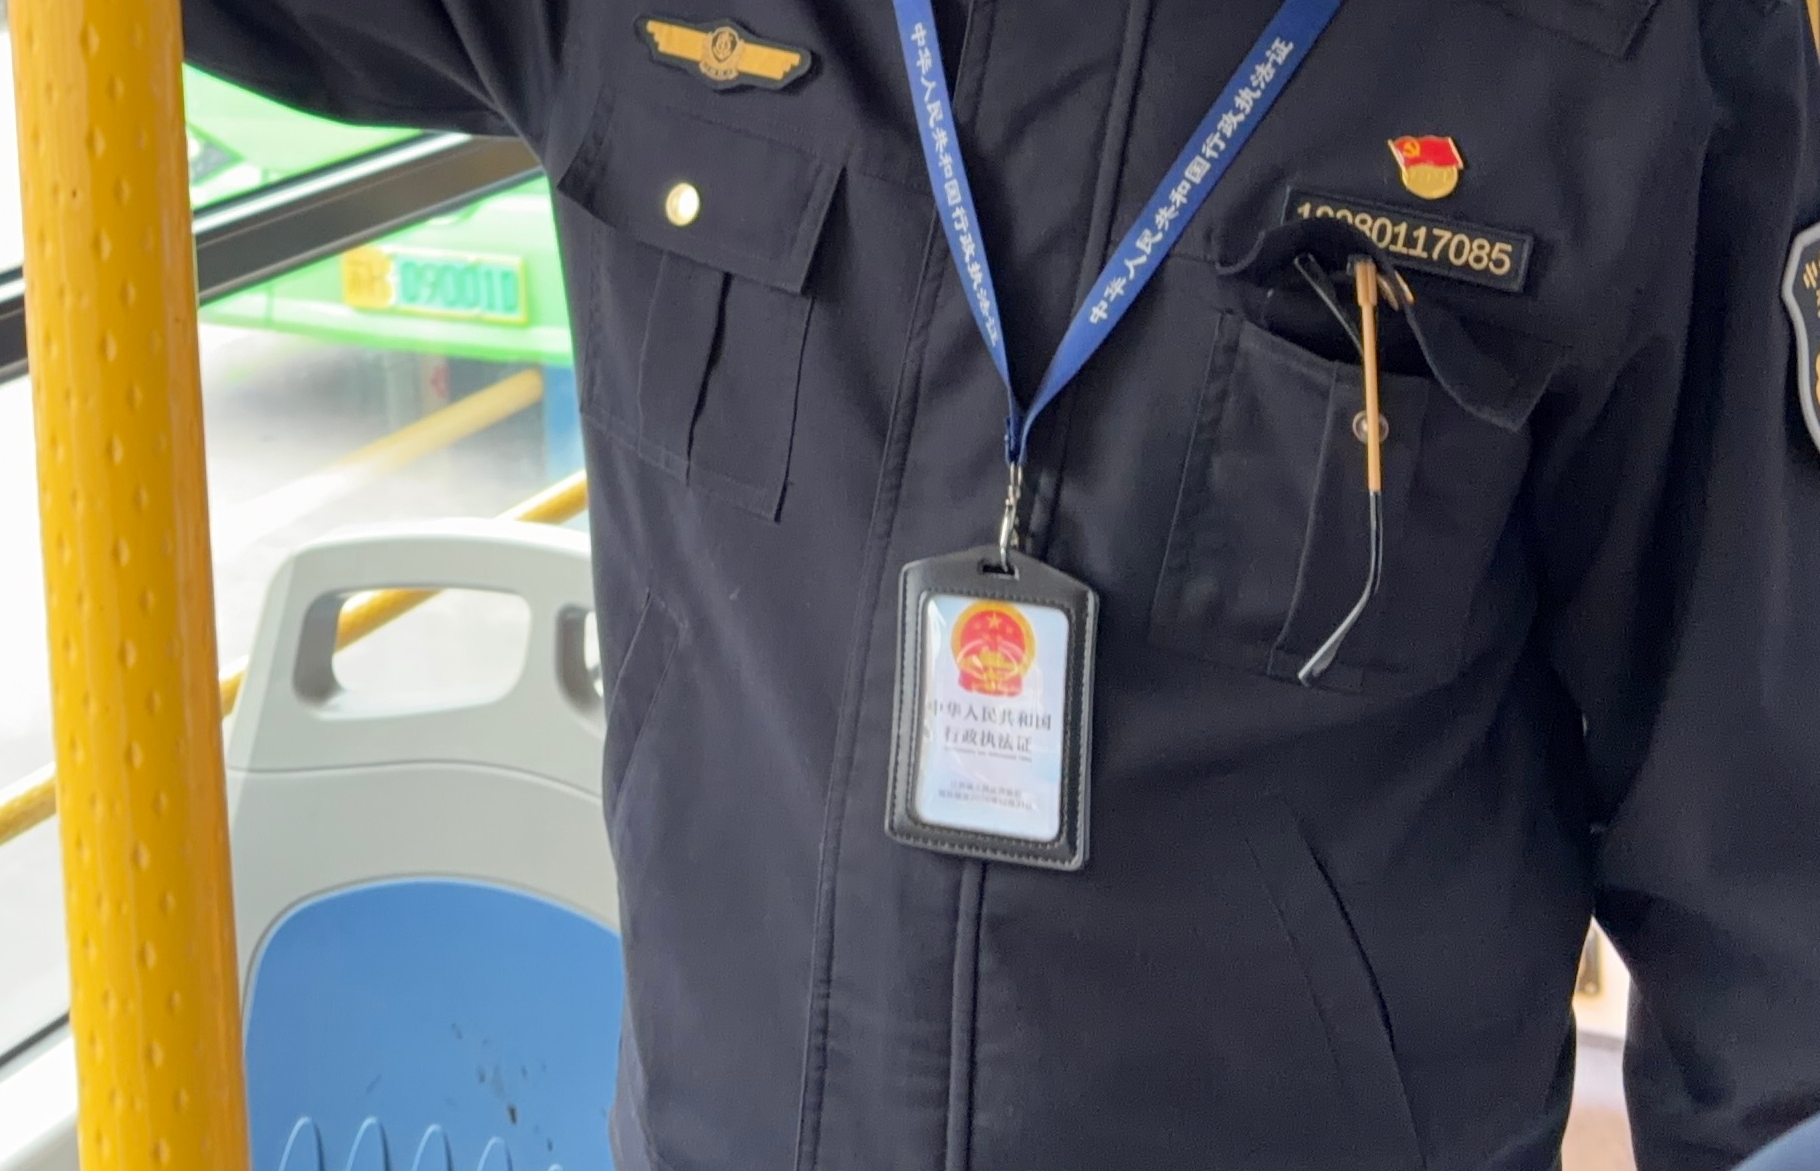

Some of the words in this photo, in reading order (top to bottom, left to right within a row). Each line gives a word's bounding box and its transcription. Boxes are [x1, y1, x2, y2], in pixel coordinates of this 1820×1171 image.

[1089, 36, 1294, 324] 中华人民共和国行政执法证
